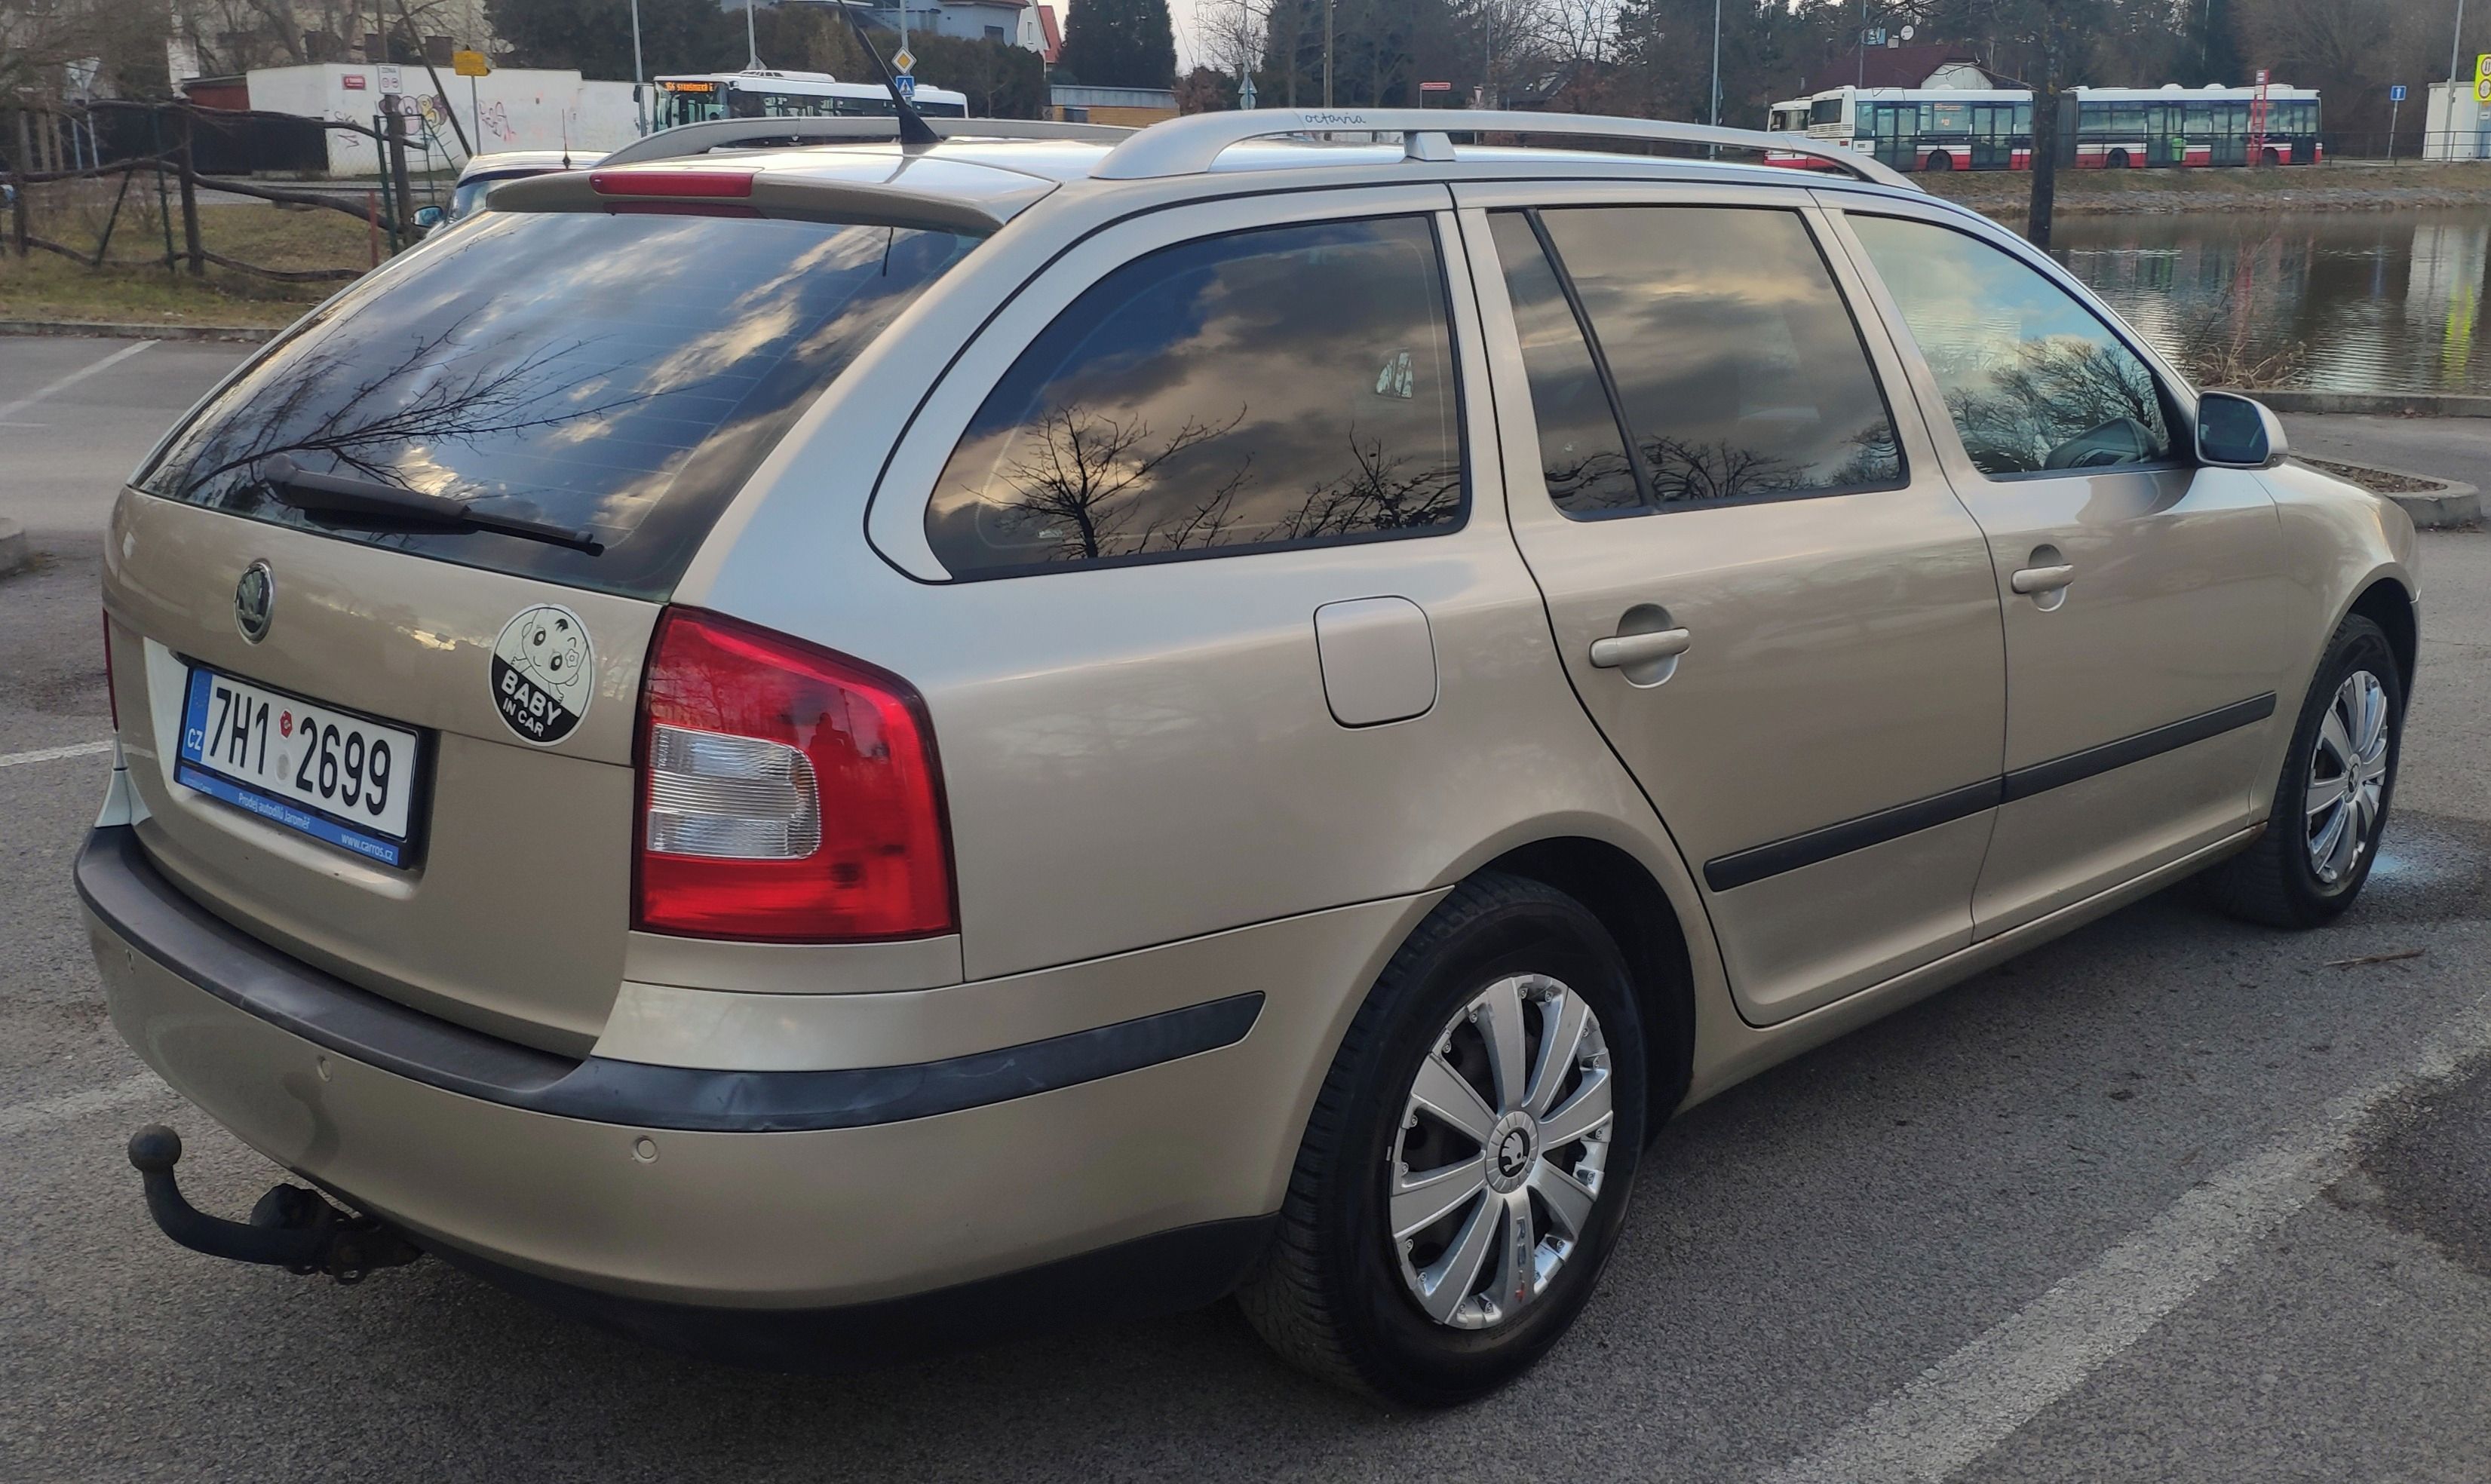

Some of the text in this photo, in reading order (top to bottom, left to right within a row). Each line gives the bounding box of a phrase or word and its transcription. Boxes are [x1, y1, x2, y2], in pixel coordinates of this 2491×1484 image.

[1305, 112, 1366, 124] octavia
[501, 669, 562, 725] BABY
[502, 697, 544, 737] IN CAR
[187, 728, 203, 751] CZ
[210, 687, 391, 816] 7H1 2699
[238, 793, 258, 812] Prodej
[341, 833, 393, 861] www.carros.cz
